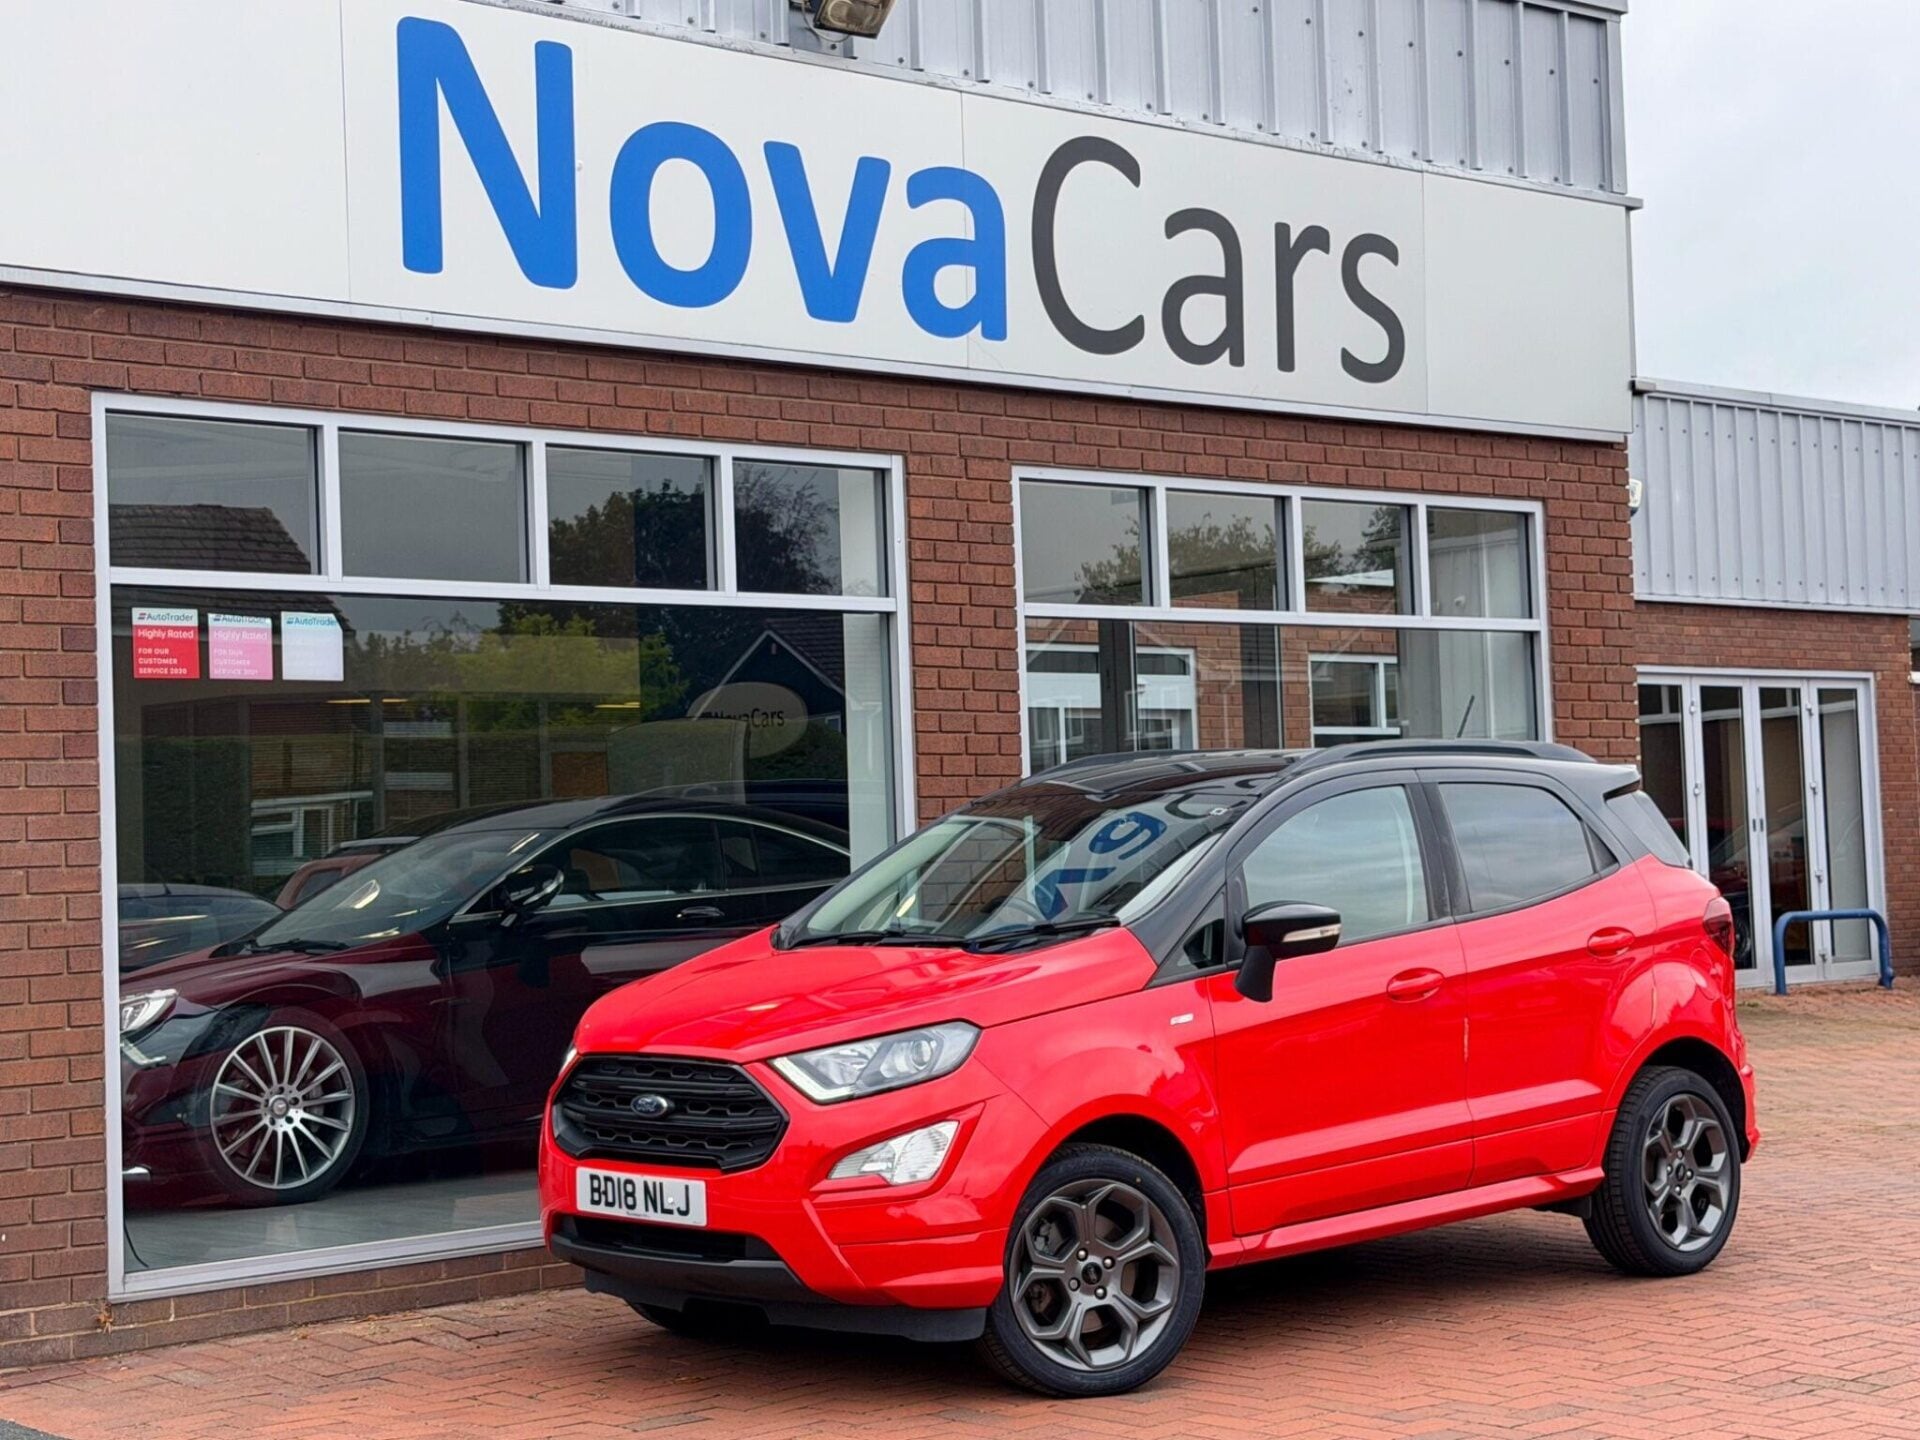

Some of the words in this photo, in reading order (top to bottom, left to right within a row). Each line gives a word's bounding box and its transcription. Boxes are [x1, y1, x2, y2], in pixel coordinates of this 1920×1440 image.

[396, 16, 1405, 383] NovaCars
[147, 612, 194, 621] AutoTrader
[138, 629, 166, 639] Highly
[167, 630, 194, 639] Rated
[589, 1173, 637, 1211] BD18
[643, 1179, 690, 1217] NLJ
